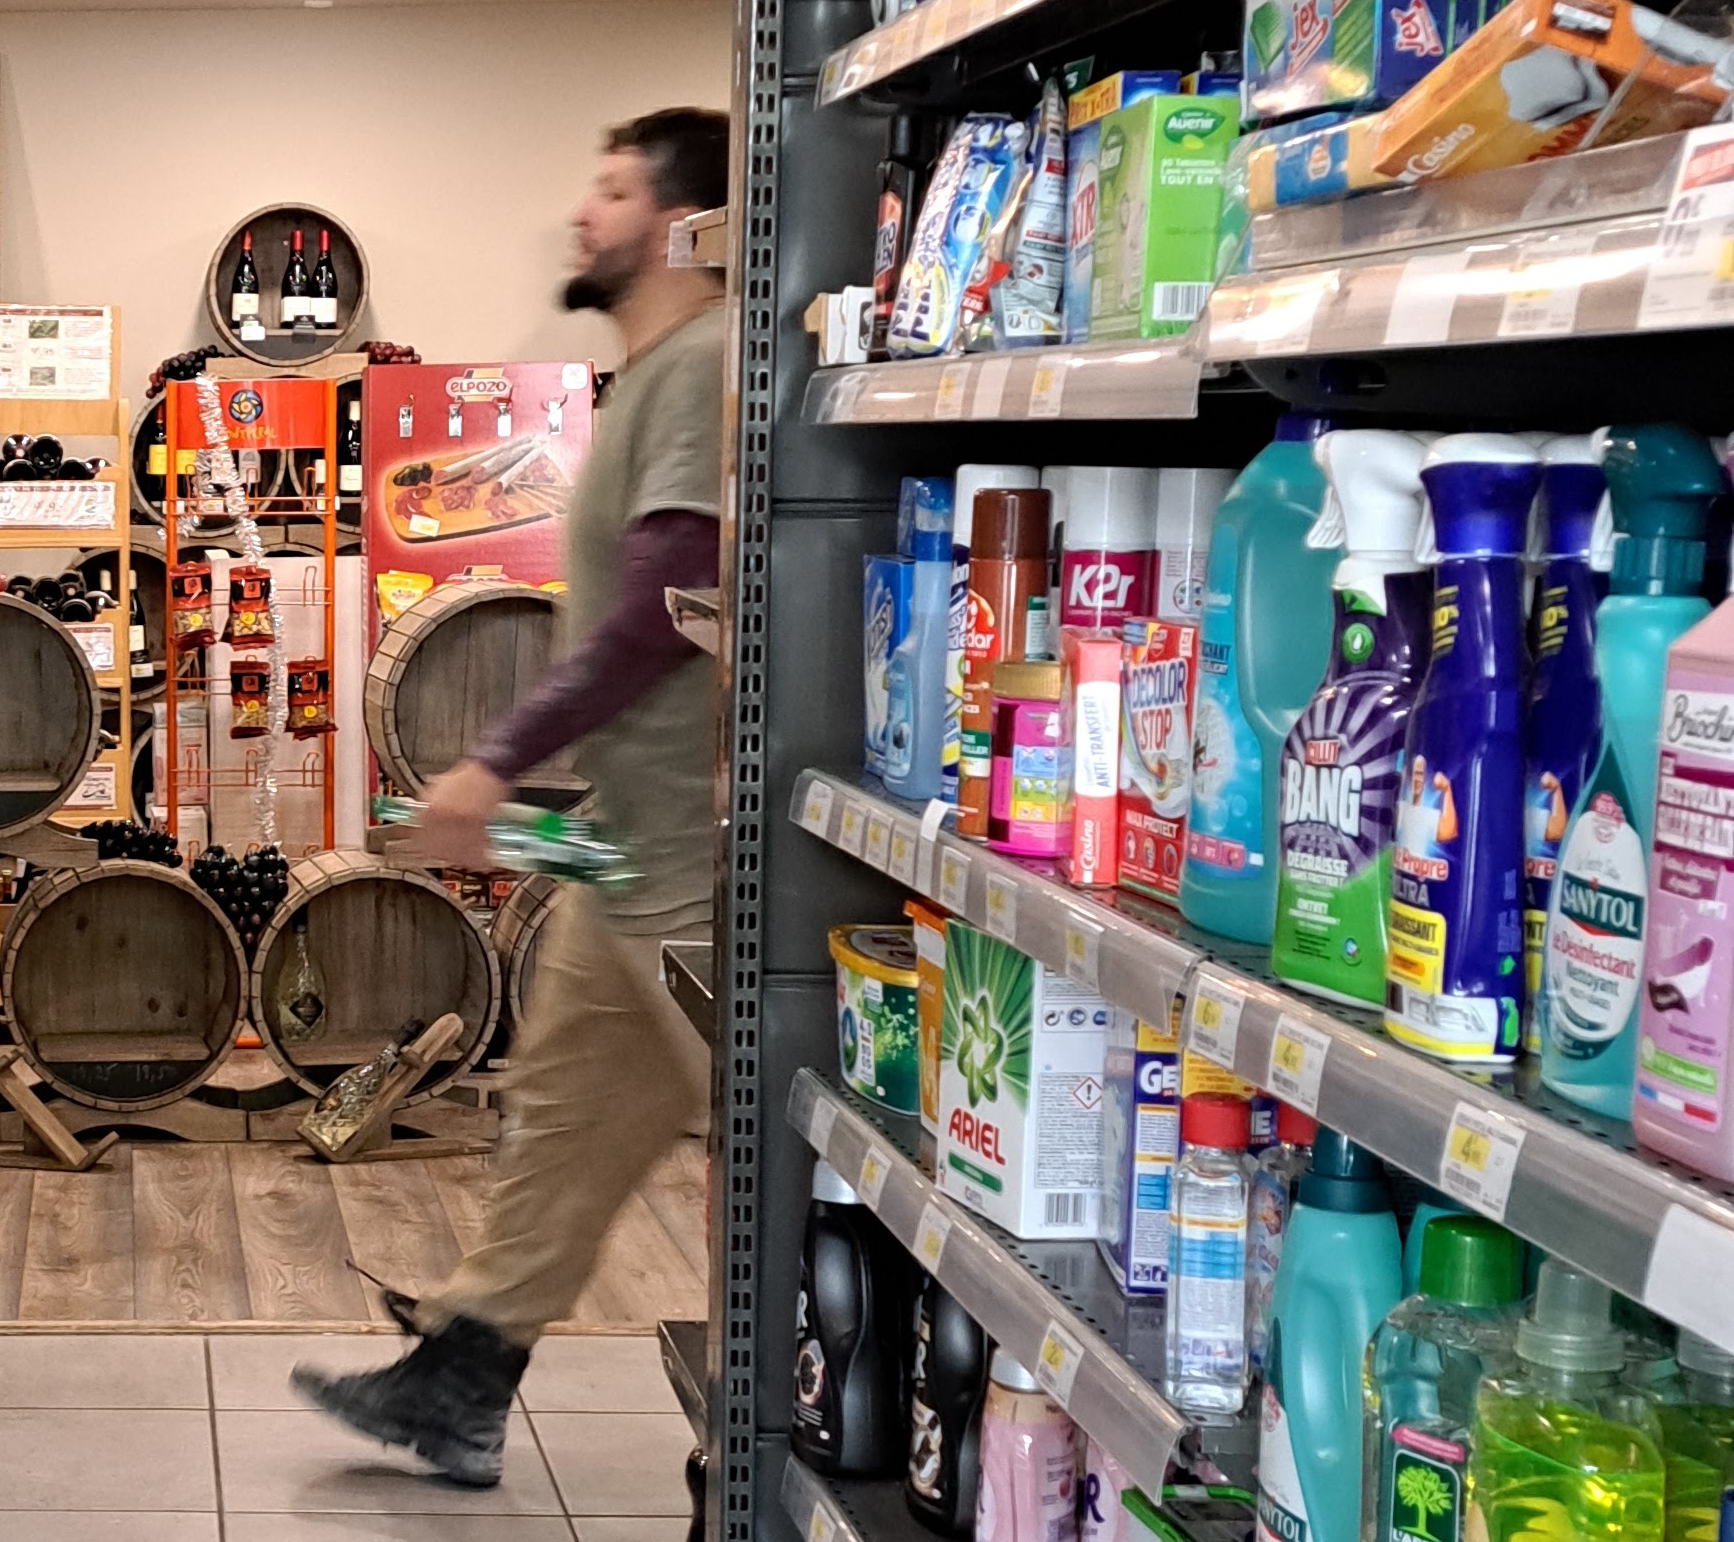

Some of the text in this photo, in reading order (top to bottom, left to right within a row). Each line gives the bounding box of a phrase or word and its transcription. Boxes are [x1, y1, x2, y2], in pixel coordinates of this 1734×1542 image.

[1068, 563, 1136, 608] K2r
[1140, 709, 1173, 752] STOP
[1285, 757, 1363, 830] BANG
[1081, 819, 1096, 870] Casino
[1563, 882, 1642, 935] SANYTOL
[948, 1108, 1006, 1166] ARIEL
